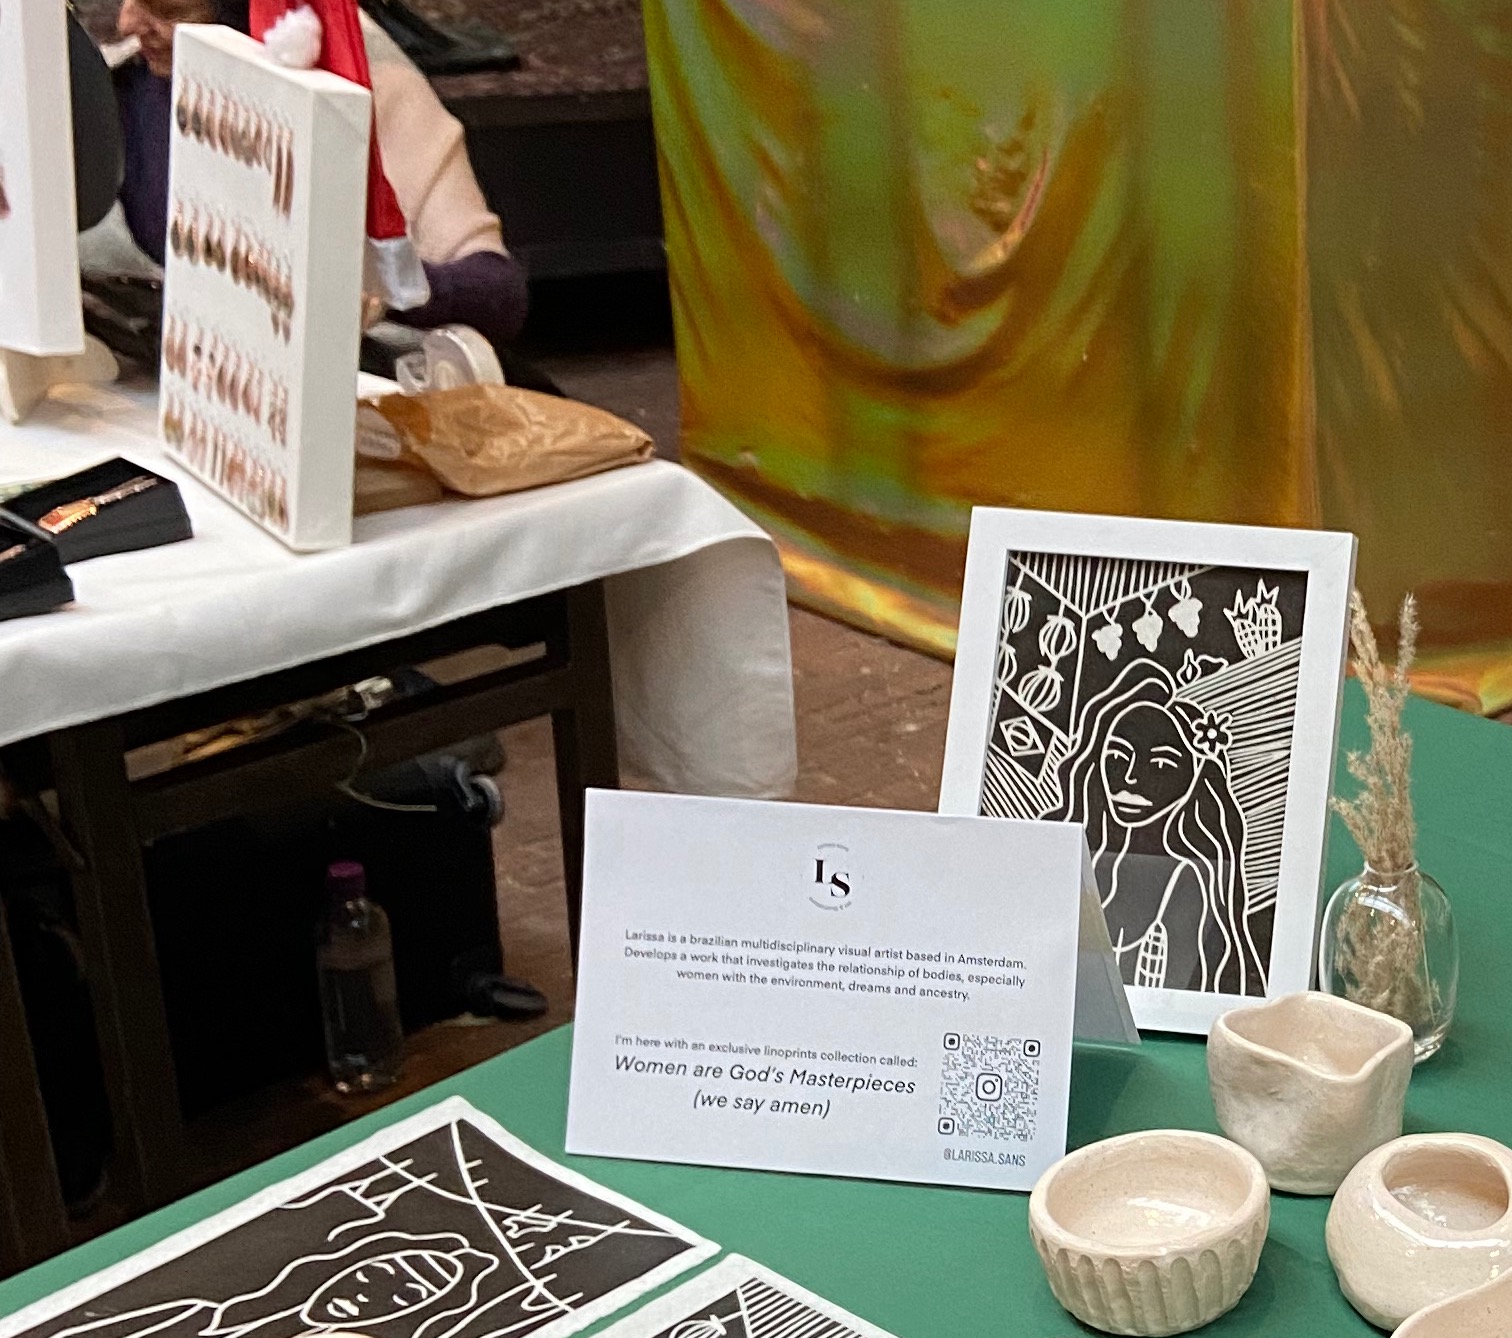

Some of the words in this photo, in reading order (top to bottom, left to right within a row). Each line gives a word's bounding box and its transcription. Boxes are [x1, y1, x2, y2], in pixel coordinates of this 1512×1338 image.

[625, 929, 664, 943] Larissa
[668, 932, 677, 943] is
[680, 935, 687, 944] a
[690, 934, 738, 947] brazilian
[741, 937, 835, 956] multidisciplinary
[838, 945, 871, 957] visual
[874, 948, 903, 959] artist
[906, 950, 941, 962] based
[945, 952, 954, 963] in
[957, 954, 1027, 969] Amsterdam.
[624, 947, 677, 962] Develops
[690, 953, 718, 963] work
[722, 954, 743, 966] that
[747, 955, 814, 971] investigates
[817, 961, 835, 972] the
[838, 962, 905, 979] relationship
[908, 968, 919, 978] of
[923, 968, 964, 983] bodies,
[968, 974, 1025, 990] especially
[676, 970, 719, 981] women
[722, 971, 746, 983] with
[749, 974, 768, 985] the
[771, 976, 845, 992] environment,
[849, 980, 891, 994] dreams
[894, 985, 916, 996] and
[919, 988, 970, 1002] ancestry.
[615, 1034, 632, 1046] I'm
[636, 1036, 661, 1048] here
[664, 1037, 688, 1050] with
[691, 1042, 706, 1051] an
[709, 1042, 761, 1055] exclusive
[764, 1045, 817, 1060] linoprints
[820, 1051, 877, 1064] collection
[880, 1055, 918, 1067] called:
[615, 1054, 687, 1076] Women
[693, 1065, 723, 1079] are
[729, 1064, 785, 1083] God's
[789, 1068, 916, 1094] Masterpieces
[693, 1089, 728, 1109] (we
[732, 1097, 766, 1115] say
[770, 1099, 831, 1119] amen)
[943, 1147, 1026, 1167] @LARISSA.SANS
